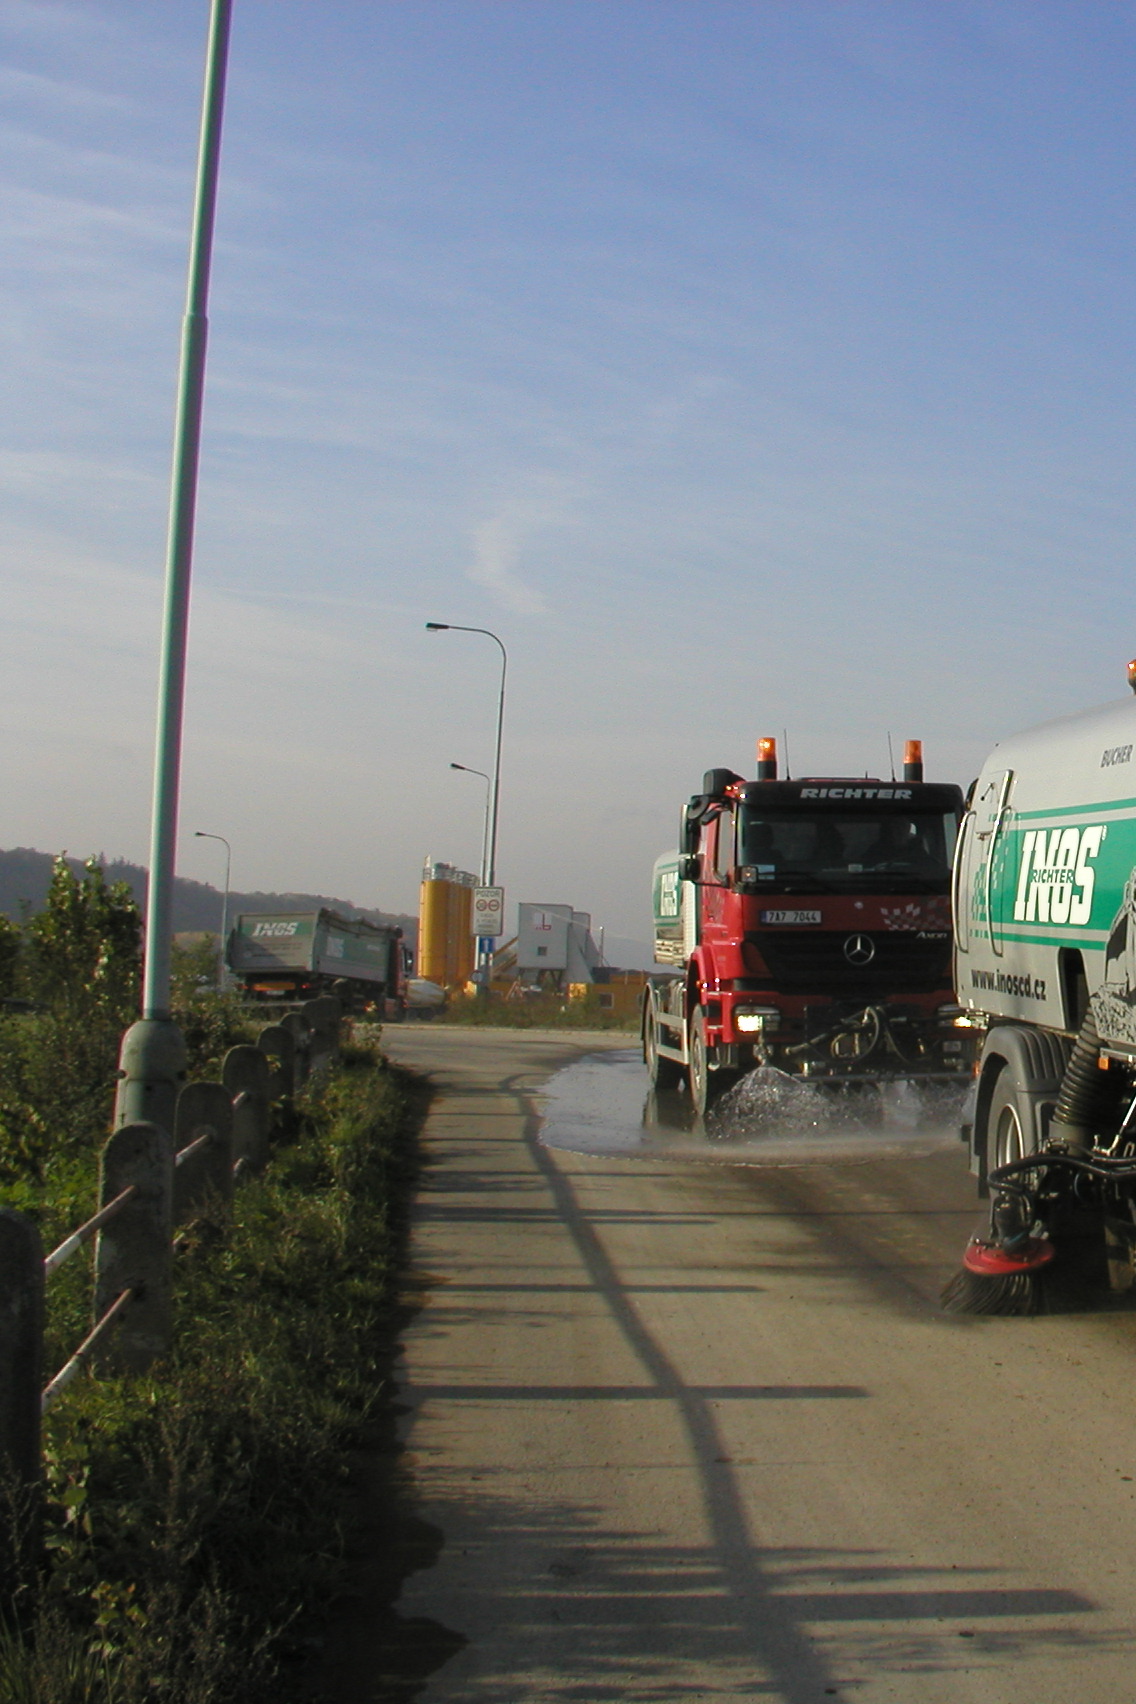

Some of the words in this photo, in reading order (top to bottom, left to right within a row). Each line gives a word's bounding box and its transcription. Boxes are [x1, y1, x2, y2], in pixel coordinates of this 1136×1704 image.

[1100, 744, 1133, 768] BUCHER
[800, 788, 912, 799] RICHTER
[1013, 825, 1104, 926] INOS
[1031, 868, 1075, 884] RICHTER
[970, 968, 1047, 1001] www.inoscd.cz
